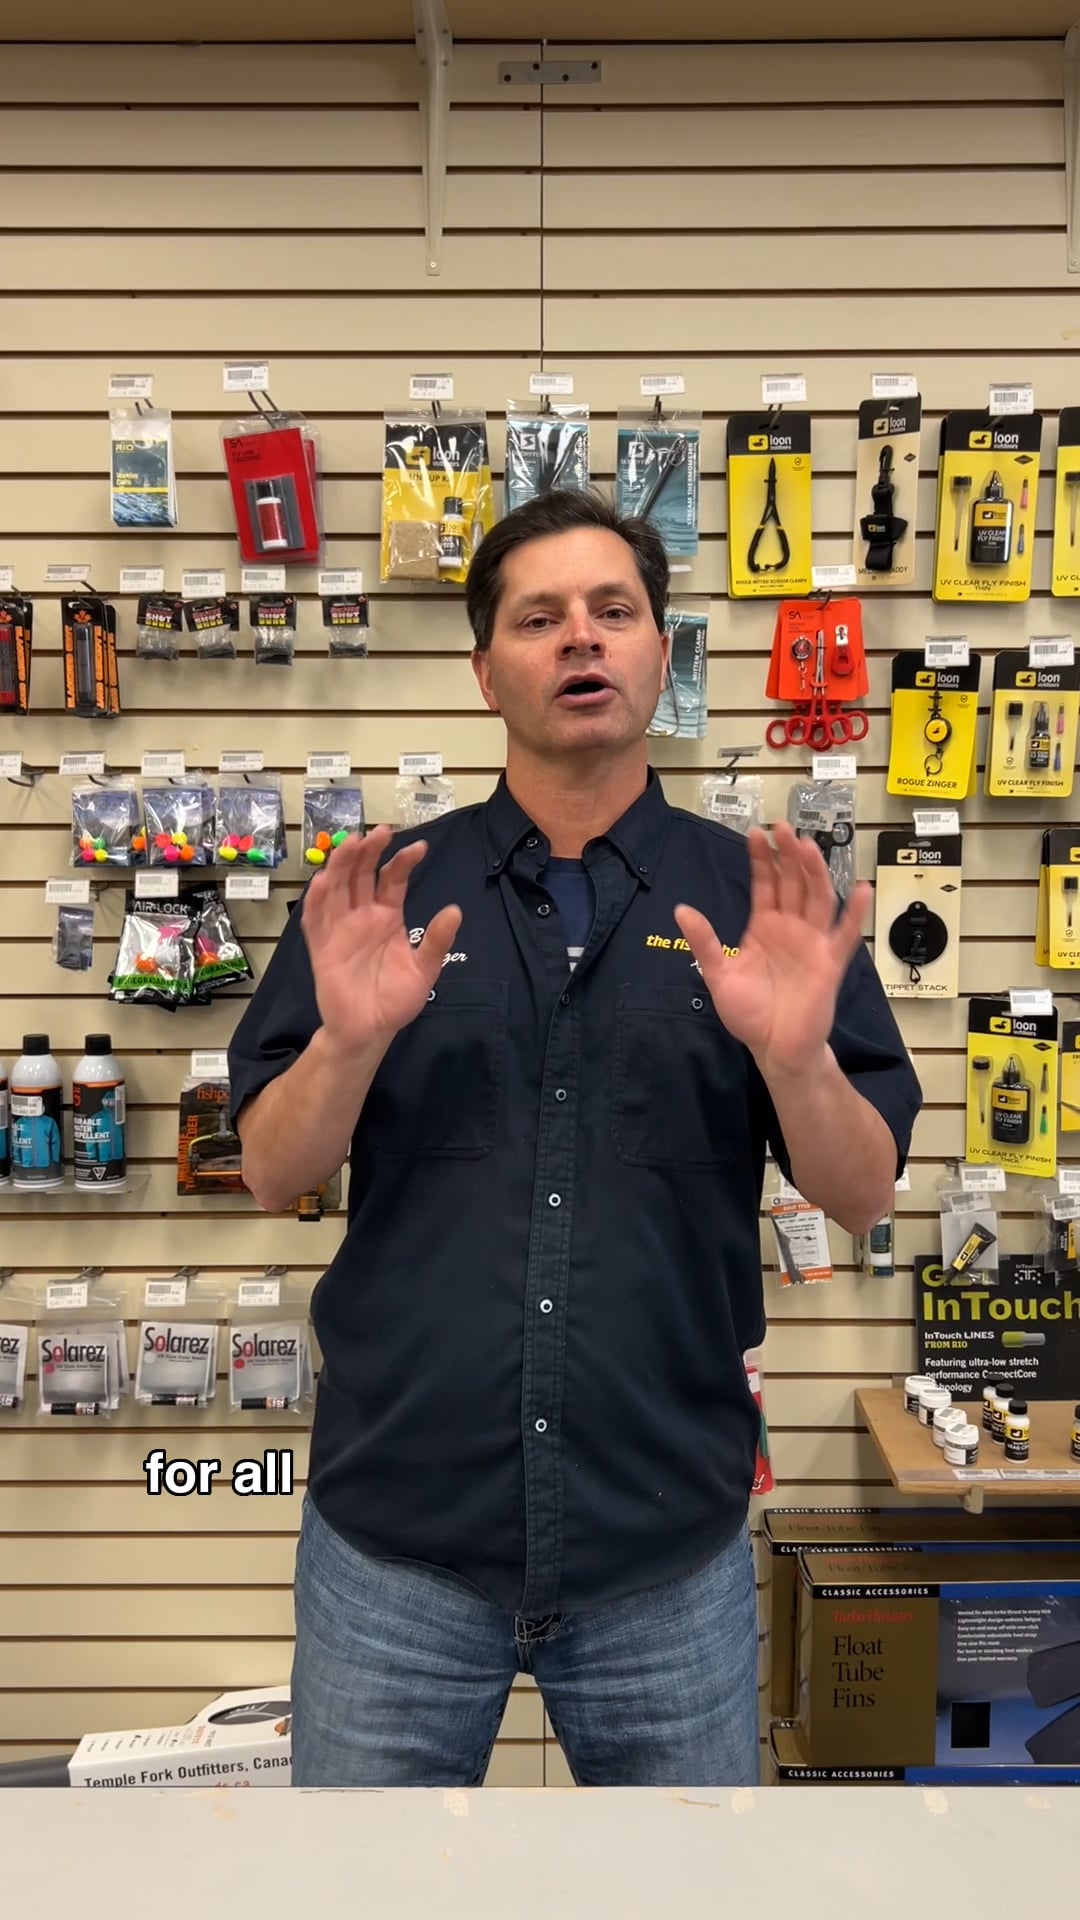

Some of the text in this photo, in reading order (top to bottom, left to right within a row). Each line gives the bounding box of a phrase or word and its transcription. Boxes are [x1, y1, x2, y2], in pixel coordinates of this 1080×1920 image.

[890, 417, 906, 428] loon
[770, 435, 791, 446] loon
[994, 431, 1019, 444] loon
[953, 579, 980, 587] CLEAR
[938, 673, 960, 684] loon
[1038, 672, 1060, 683] loon
[896, 777, 958, 789] ROGUE ZINGER
[919, 849, 942, 860] loon
[645, 935, 672, 949] the
[885, 983, 948, 992] TIPPET STACK
[1013, 1019, 1037, 1032] loon
[969, 1147, 1052, 1163] UV CLEAR FLY FINISH
[923, 1290, 1080, 1321] InTouch
[143, 1326, 210, 1355] Solarez
[924, 1331, 995, 1340] InTouch LINES
[41, 1338, 105, 1363] Solarez
[232, 1332, 297, 1358] Solarez
[924, 1341, 968, 1349] FROM RIO
[925, 1357, 1039, 1369] Featuring ultra-low stretch
[925, 1370, 980, 1380] performance
[822, 1587, 929, 1596] CLASSIC ACCESSORIES
[833, 1634, 885, 1656] Float
[831, 1660, 885, 1682] Tube
[833, 1687, 876, 1709] Fins
[85, 1773, 136, 1787] Temple
[141, 1767, 174, 1784] Fork
[178, 1760, 249, 1779] Outfitters,
[788, 1769, 895, 1778] CLASSIC ACCESSORIES
